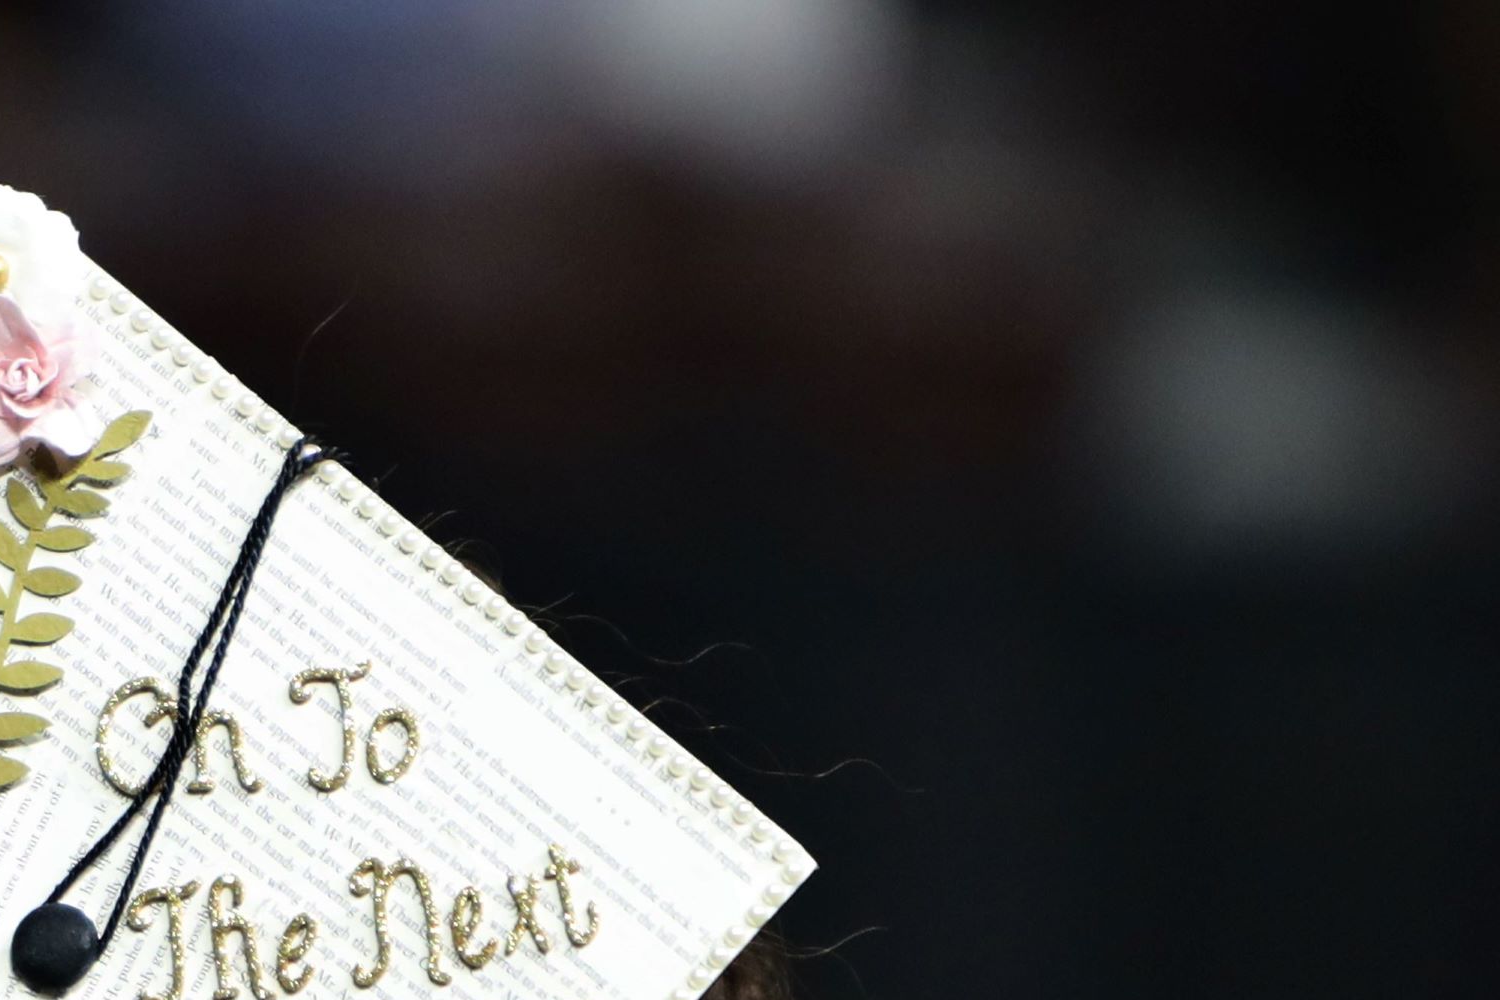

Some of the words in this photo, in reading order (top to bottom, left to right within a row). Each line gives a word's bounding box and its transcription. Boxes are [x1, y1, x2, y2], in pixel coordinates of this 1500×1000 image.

[105, 323, 153, 362] elevator
[156, 475, 184, 501] then
[191, 501, 219, 528] bury
[195, 478, 227, 504] push
[150, 498, 187, 535] breath
[187, 531, 233, 571] without
[203, 419, 231, 444] stick
[322, 513, 376, 558] saturated
[414, 587, 455, 621] absorb
[453, 618, 501, 657] another
[96, 554, 125, 577] until
[154, 597, 183, 625] both
[172, 552, 211, 585] ushers
[119, 601, 156, 635] finally
[155, 631, 192, 662] reach
[181, 593, 215, 620] picks
[267, 563, 302, 593] under
[318, 605, 346, 630] chin
[367, 641, 394, 669] look
[394, 665, 428, 695] down
[290, 551, 323, 577] until
[334, 586, 379, 625] releases
[398, 637, 438, 672] mouth
[437, 666, 468, 695] from
[93, 613, 120, 637] with
[141, 652, 168, 674] still
[308, 626, 341, 657] wraps
[71, 659, 104, 689] doors
[51, 708, 95, 741] gather
[97, 675, 264, 798] On
[290, 660, 418, 792] To
[267, 722, 332, 779] approaches
[218, 776, 253, 808] inside
[207, 798, 240, 828] reach
[260, 839, 295, 873] hands
[2, 873, 21, 902] care
[15, 833, 40, 871] about
[135, 866, 156, 897] stop
[230, 849, 266, 881] excess
[349, 843, 600, 988] Next
[117, 937, 145, 984] pushes
